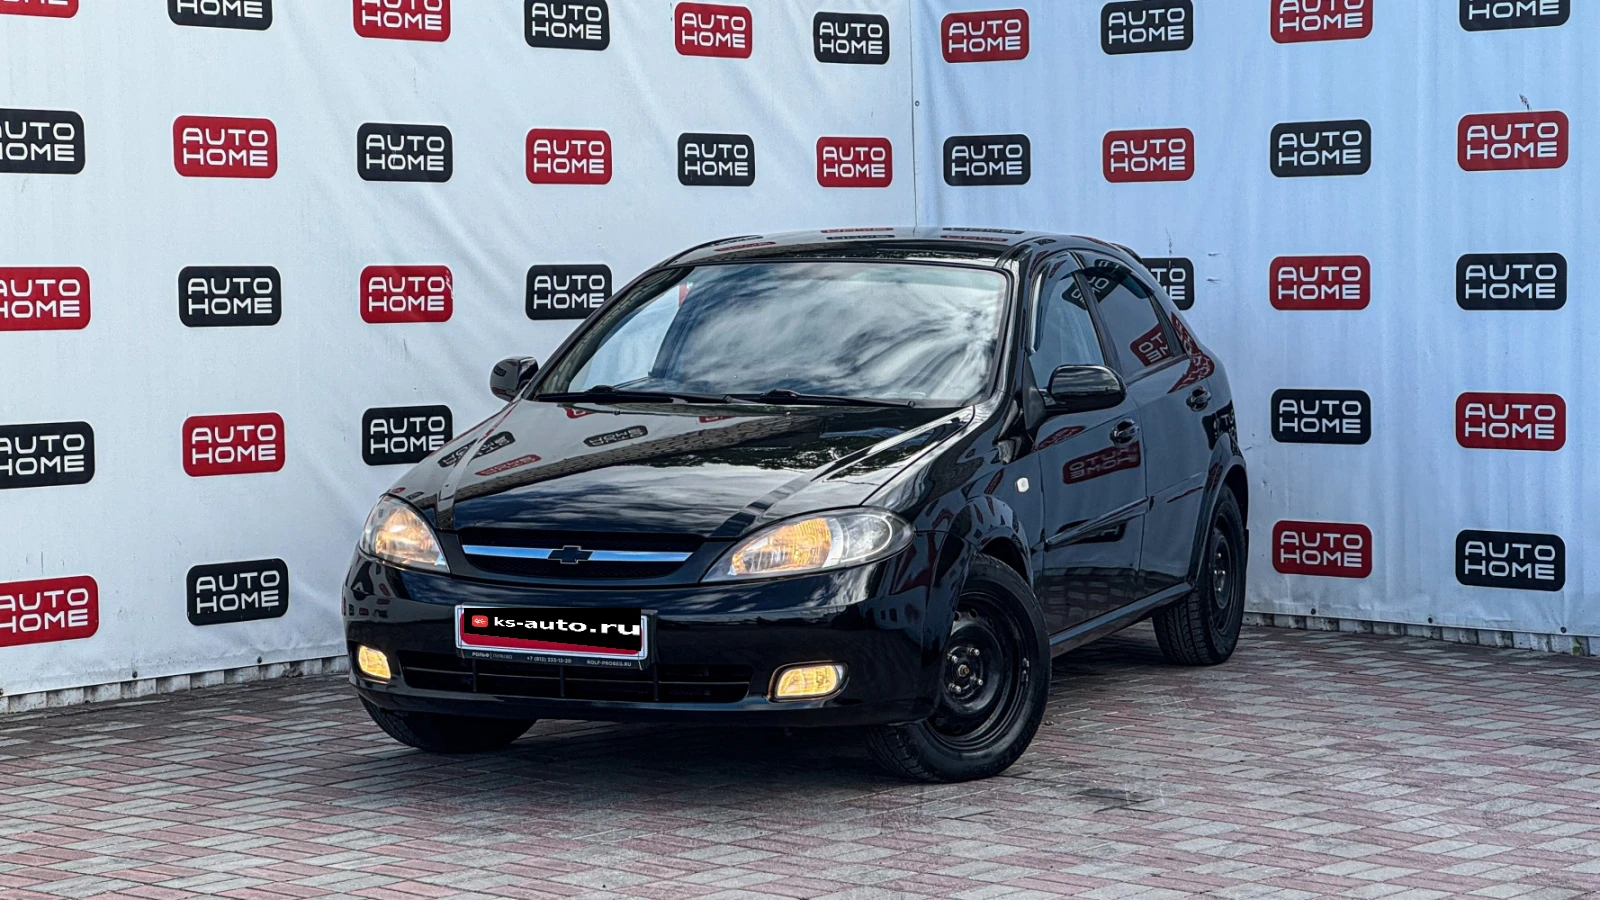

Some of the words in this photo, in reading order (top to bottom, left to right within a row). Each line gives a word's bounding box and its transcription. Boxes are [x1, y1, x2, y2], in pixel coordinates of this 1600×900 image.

[176, 0, 263, 19] HOME
[531, 2, 602, 22] AUTO
[1108, 7, 1185, 27] AUTO
[1468, 0, 1560, 20] HOME
[361, 9, 443, 31] HOME
[681, 12, 746, 31] AUTO
[819, 21, 883, 38] AUTO
[948, 18, 1022, 37] AUTO
[1279, 11, 1364, 33] HOME
[532, 20, 602, 40] HOME
[681, 30, 746, 49] HOME
[1108, 25, 1185, 45] HOME
[819, 38, 883, 55] HOME
[948, 35, 1021, 53] HOME
[0, 120, 76, 141] UTO
[182, 127, 269, 147] AUTO
[1278, 130, 1362, 149] AUTO
[1466, 122, 1559, 142] AUTO
[0, 141, 75, 162] OME
[365, 134, 445, 153] AUTO
[533, 139, 605, 156] AUTO
[684, 143, 749, 159] AUTO
[951, 144, 1023, 160] AUTO
[1110, 138, 1187, 156] AUTO
[1466, 141, 1558, 160] HOME
[182, 147, 269, 167] HOME
[365, 153, 444, 172] HOME
[822, 146, 886, 161] AUTO
[1278, 148, 1361, 167] HOME
[533, 157, 605, 174] HOME
[684, 160, 749, 176] HOME
[823, 163, 886, 178] HOME
[951, 160, 1022, 177] HOME
[1110, 155, 1186, 173] HOME
[1150, 267, 1186, 283] TO
[1278, 265, 1362, 282] AUTO
[1465, 264, 1557, 280] AUTO
[187, 277, 273, 295] AUTO
[368, 276, 446, 293] AUTO
[534, 274, 605, 291] AUTO
[1278, 284, 1361, 300] HOME
[1465, 283, 1556, 299] HOME
[188, 297, 273, 316] HOME
[368, 295, 445, 312] HOME
[533, 292, 605, 310] HOME
[1279, 399, 1362, 416] AUTO
[1465, 403, 1556, 421] AUTO
[191, 424, 277, 445] AUTO
[370, 416, 445, 435] AUTO
[1279, 417, 1362, 434] HOME
[1465, 421, 1555, 440] HOME
[191, 443, 277, 465] HOME
[370, 434, 445, 455] HOME
[1281, 531, 1363, 550] AUTO
[1280, 548, 1362, 568] HOME
[1465, 541, 1556, 561] AUTO
[1464, 559, 1555, 580] HOME
[196, 570, 280, 594] AUTO
[0, 588, 89, 612] AUTO
[196, 589, 280, 614] HOME
[0, 608, 89, 634] HOME
